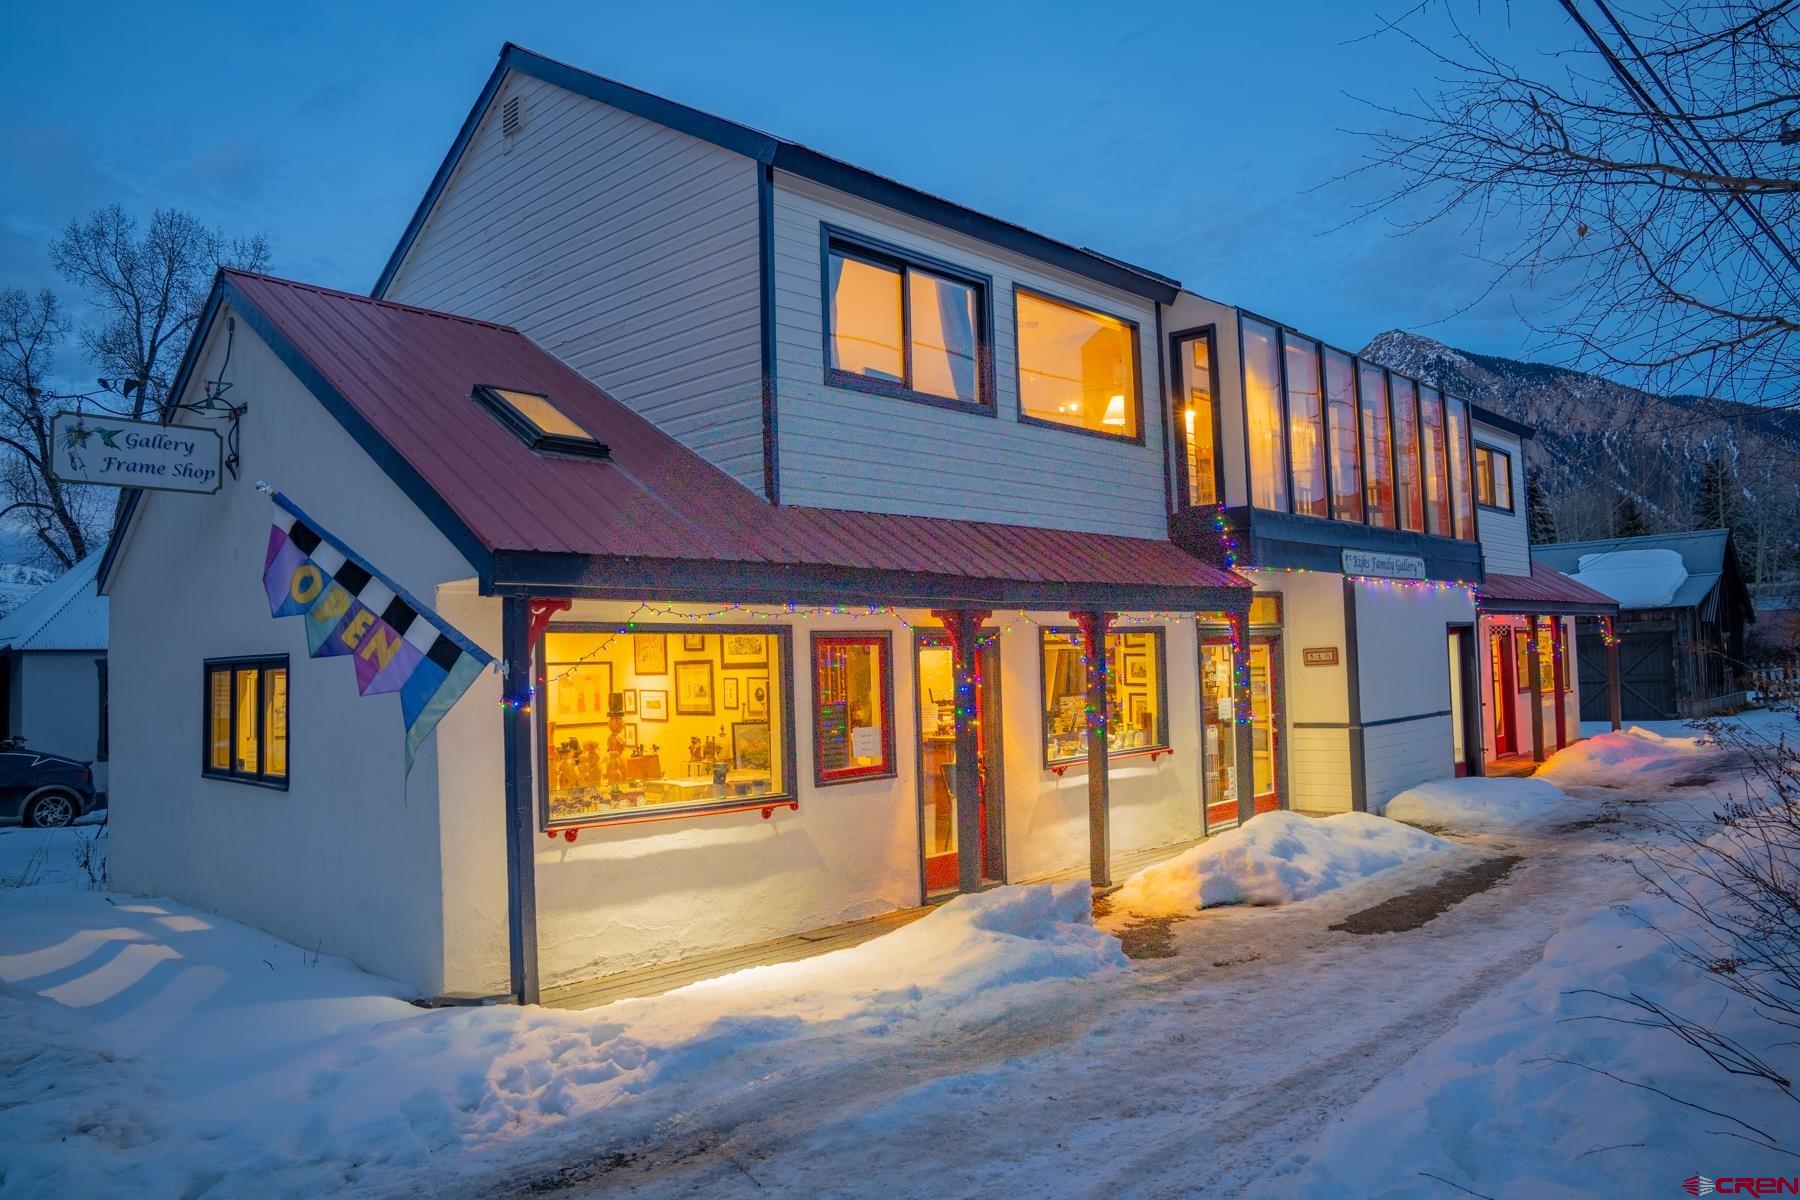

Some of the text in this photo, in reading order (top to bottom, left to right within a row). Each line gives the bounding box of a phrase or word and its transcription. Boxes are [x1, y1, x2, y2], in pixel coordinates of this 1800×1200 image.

[125, 432, 195, 457] Gallery
[99, 456, 216, 484] Frame Shop
[1371, 556, 1395, 575] Family
[1395, 558, 1418, 576] Gallery
[290, 564, 404, 672] OPEN
